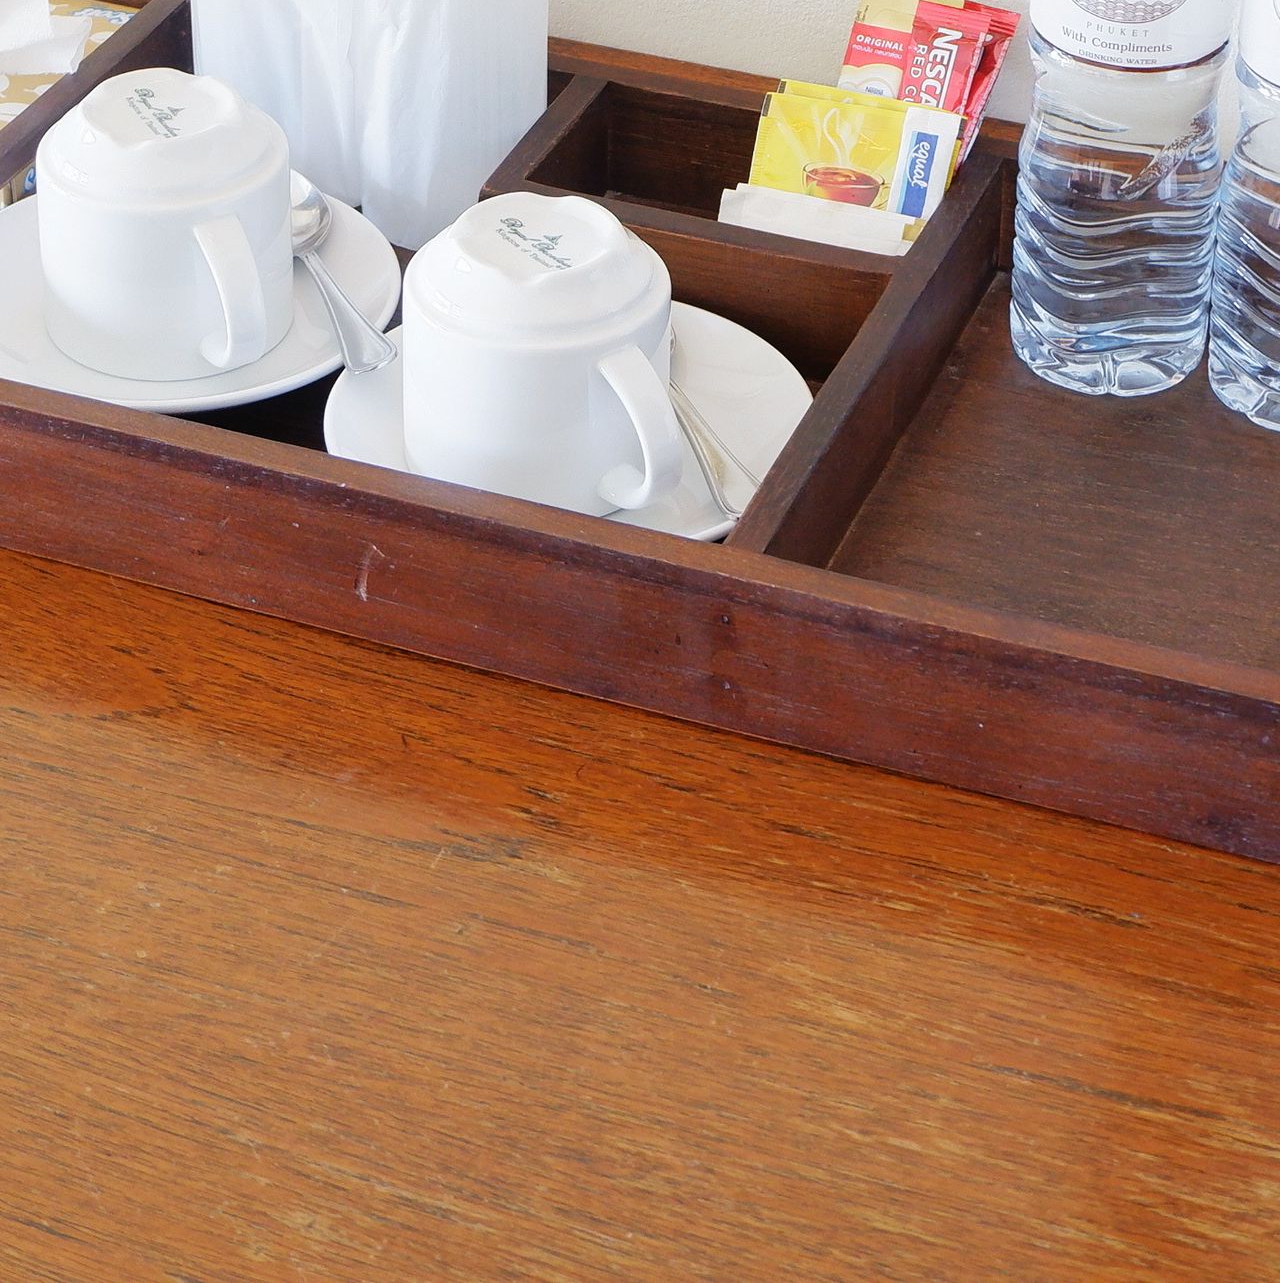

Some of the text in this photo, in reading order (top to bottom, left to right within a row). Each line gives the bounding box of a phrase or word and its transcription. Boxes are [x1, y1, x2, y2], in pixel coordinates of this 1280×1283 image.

[1062, 25, 1172, 55] With Compliments
[1085, 21, 1151, 38] PHUKET
[856, 35, 905, 51] ORIGINAL
[910, 45, 928, 78] RED
[1078, 49, 1157, 65] DRINKING WATER
[909, 141, 931, 188] equal
[496, 228, 520, 248] Kingdom
[500, 218, 542, 241] Royal
